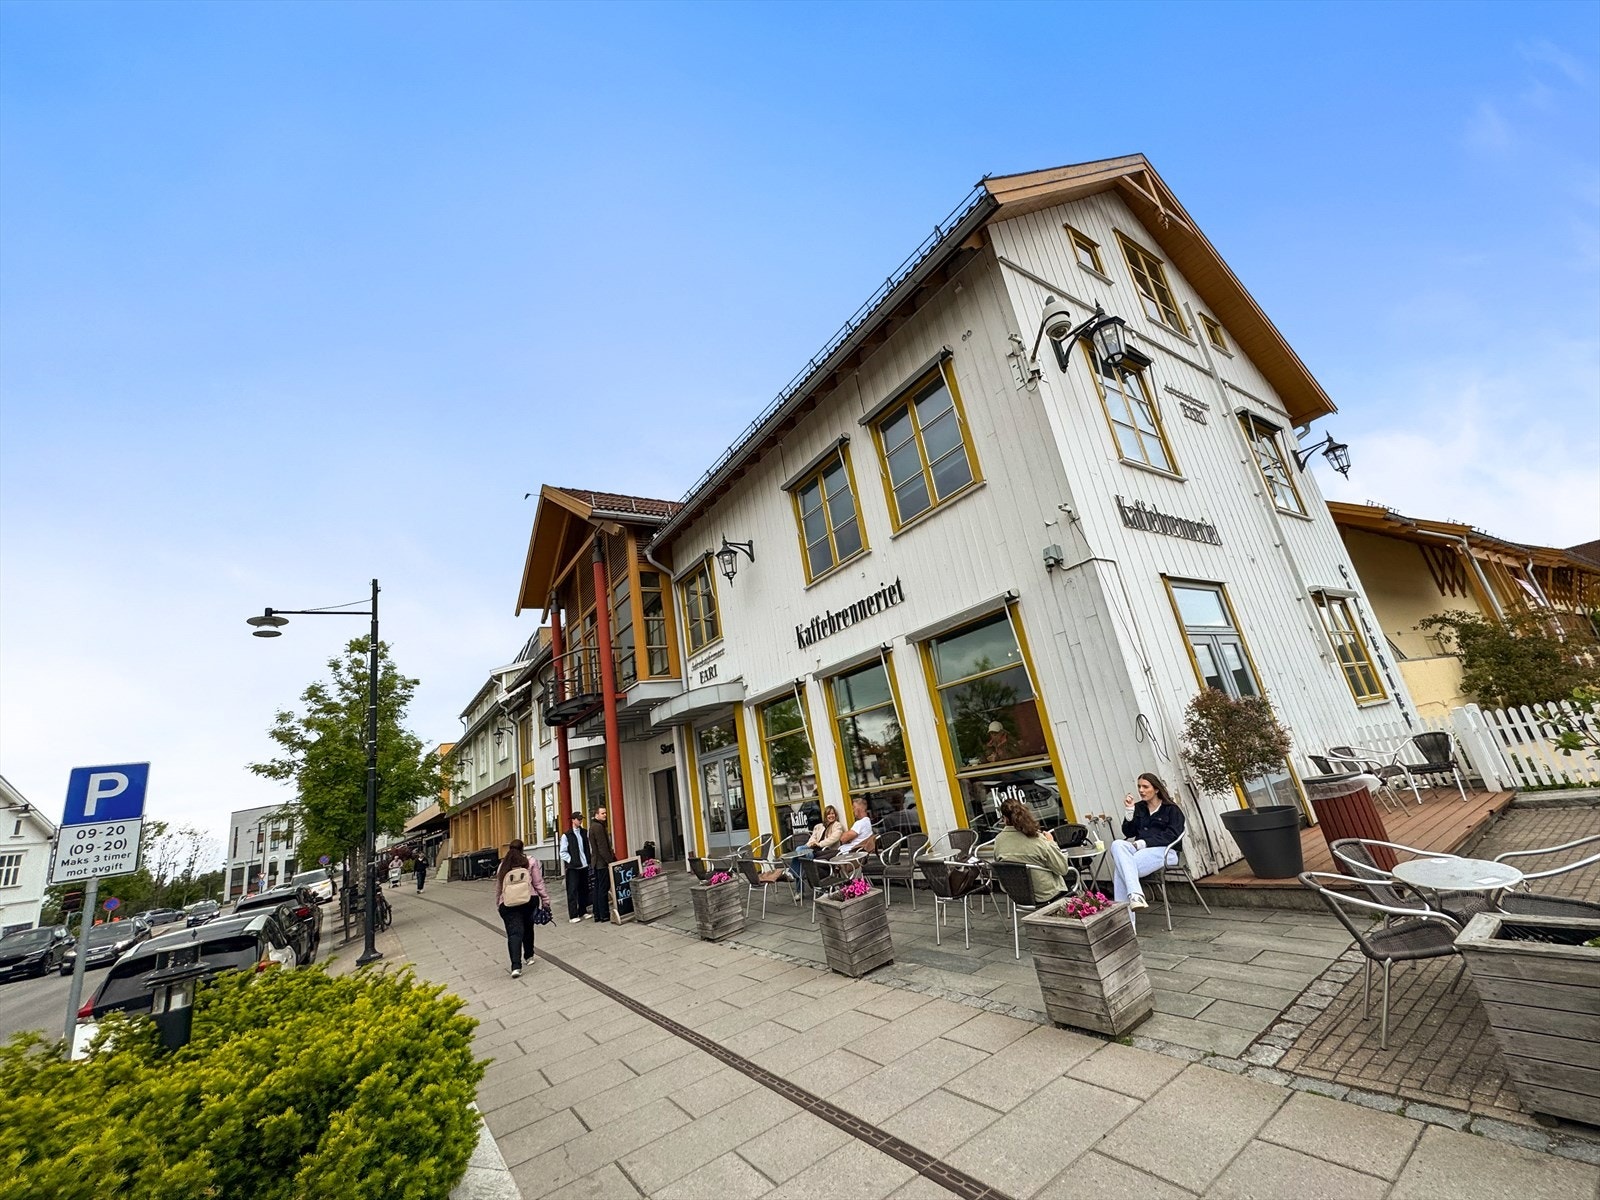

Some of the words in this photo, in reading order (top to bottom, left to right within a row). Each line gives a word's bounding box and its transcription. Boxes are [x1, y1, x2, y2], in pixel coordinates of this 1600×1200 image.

[1114, 494, 1222, 546] Kaffebrenneriet
[795, 575, 905, 650] Kaffebrenneriet
[83, 772, 129, 817] P
[991, 784, 1026, 808] Kaffe
[790, 811, 809, 827] Kaffe
[76, 825, 125, 840] 09-20
[69, 839, 127, 856] (09-20)
[61, 856, 89, 867] Maks
[93, 854, 100, 863] 3
[103, 851, 132, 862] timer
[66, 868, 87, 877] mot
[91, 862, 123, 875] avgift
